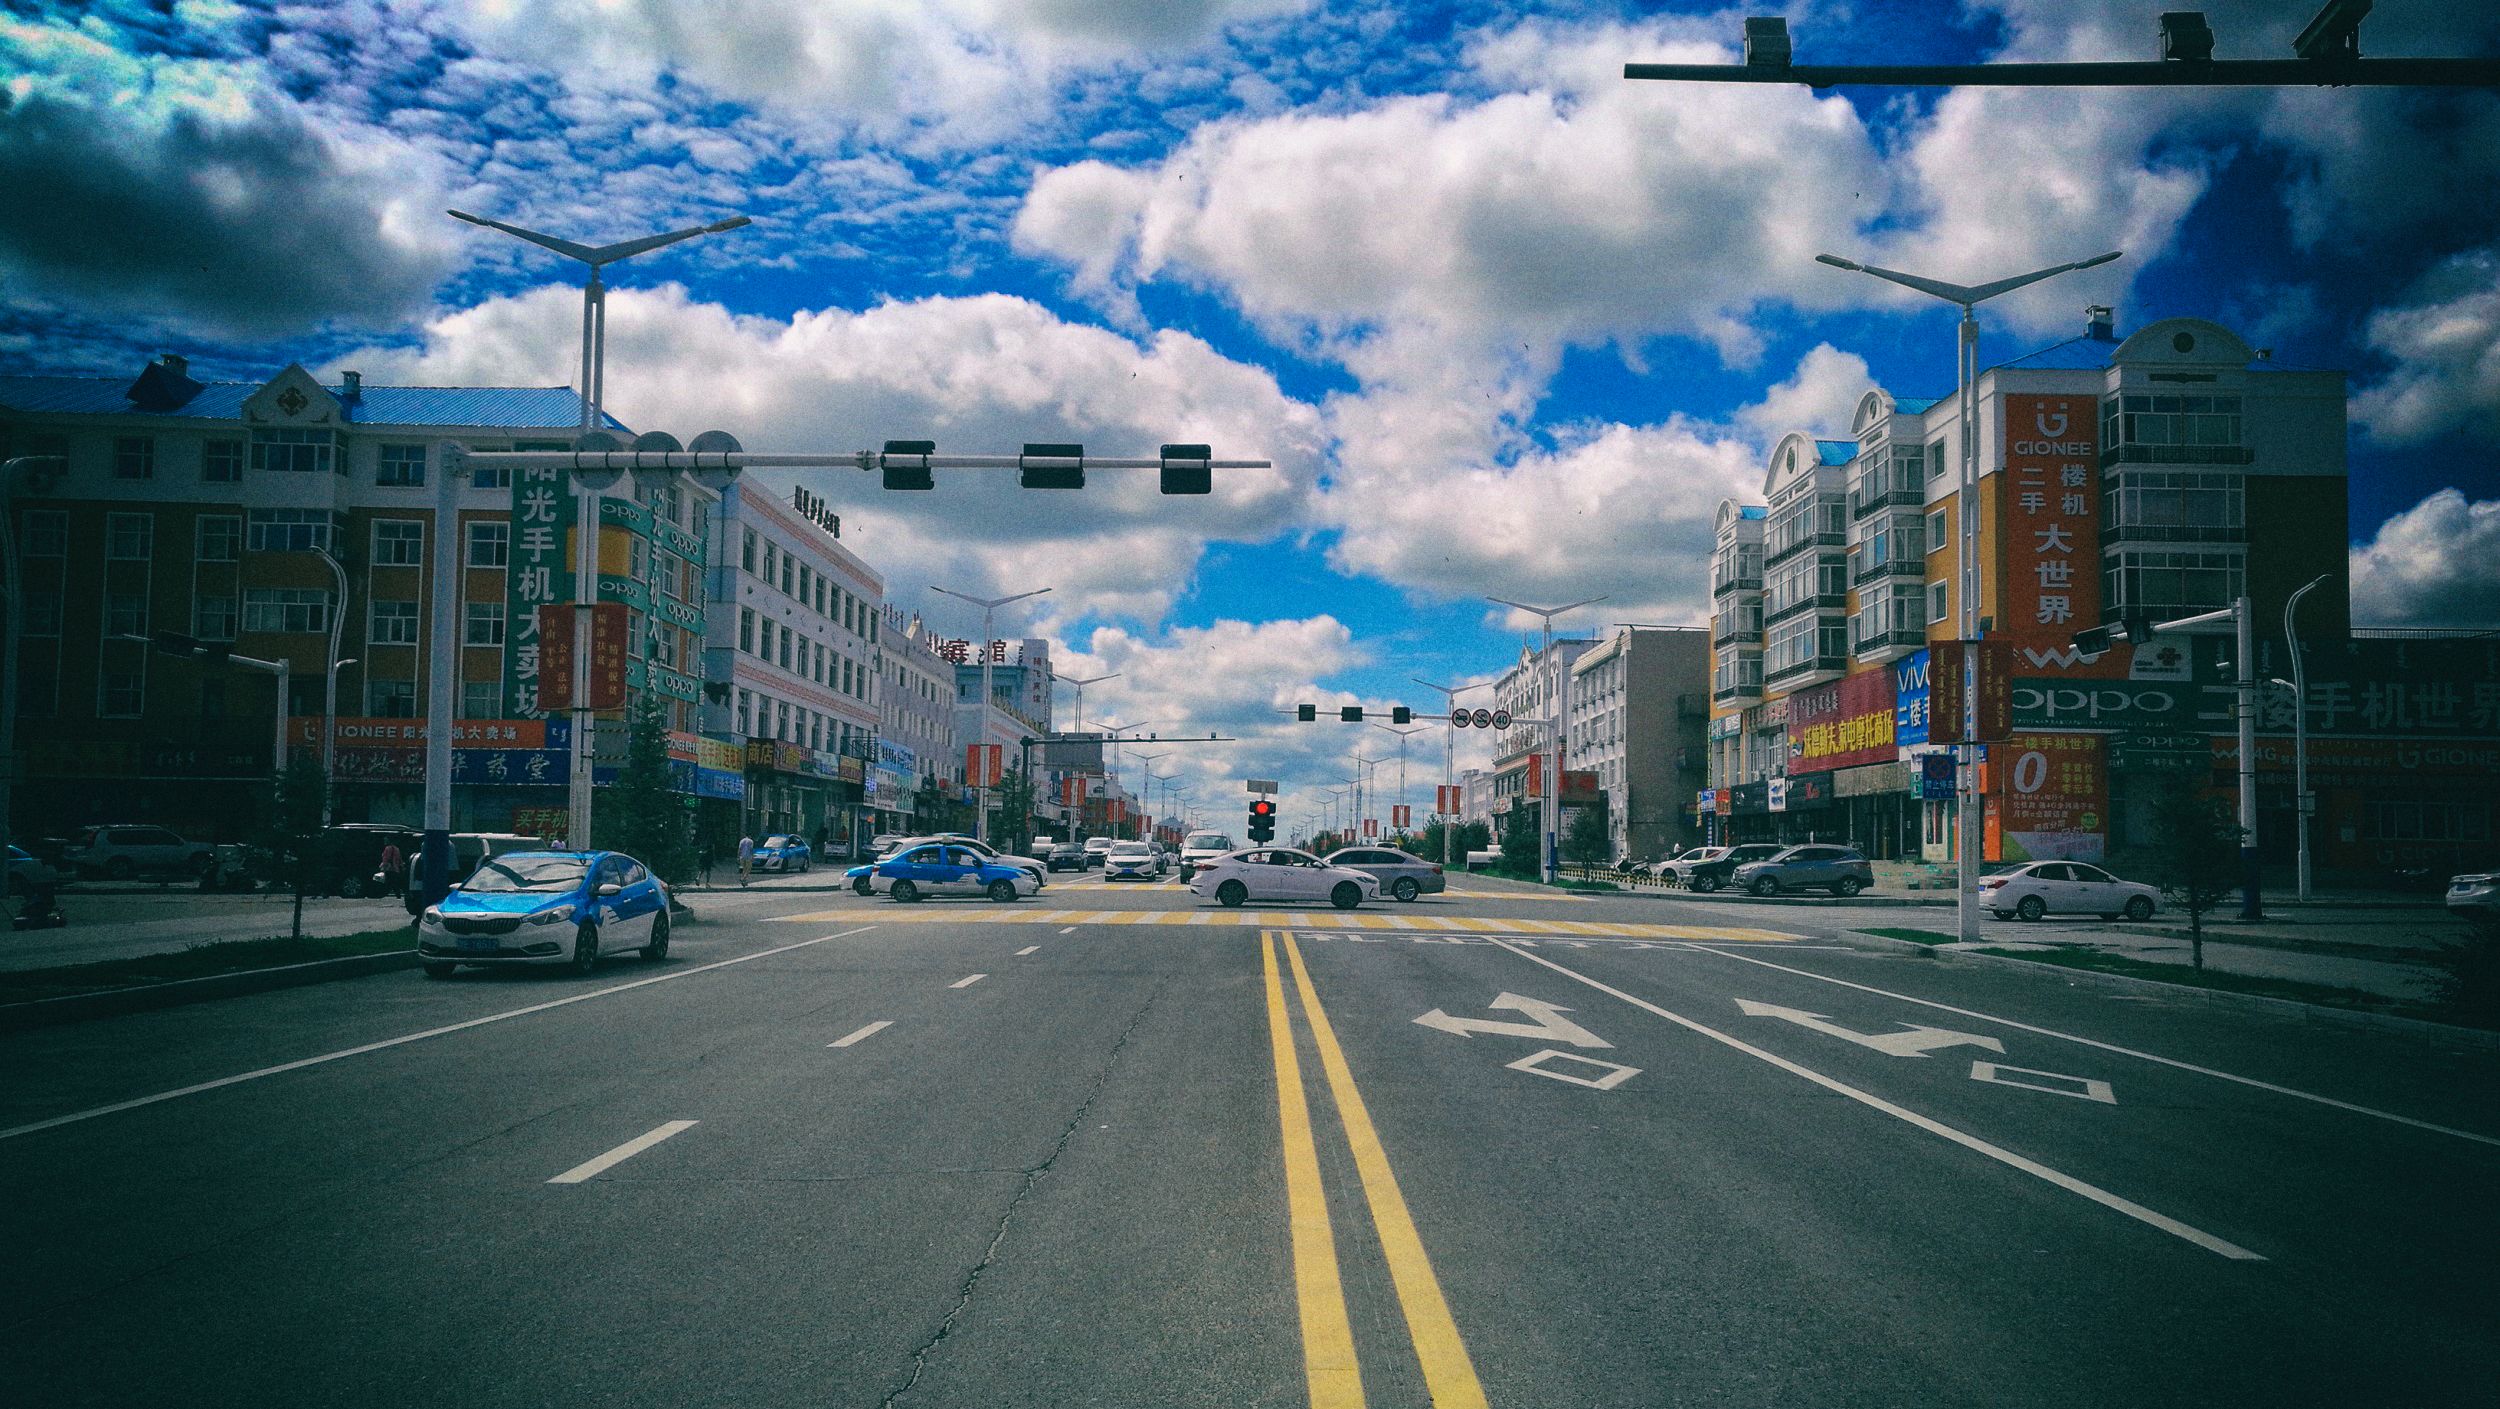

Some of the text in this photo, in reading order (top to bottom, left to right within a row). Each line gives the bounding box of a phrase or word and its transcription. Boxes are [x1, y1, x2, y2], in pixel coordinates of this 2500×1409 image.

[2014, 441, 2092, 457] GIONEE
[2034, 522, 2075, 625] 大世界
[1496, 715, 1507, 725] 40
[337, 725, 517, 740] IONEE 阳光机大卖场
[2014, 751, 2048, 793] 0
